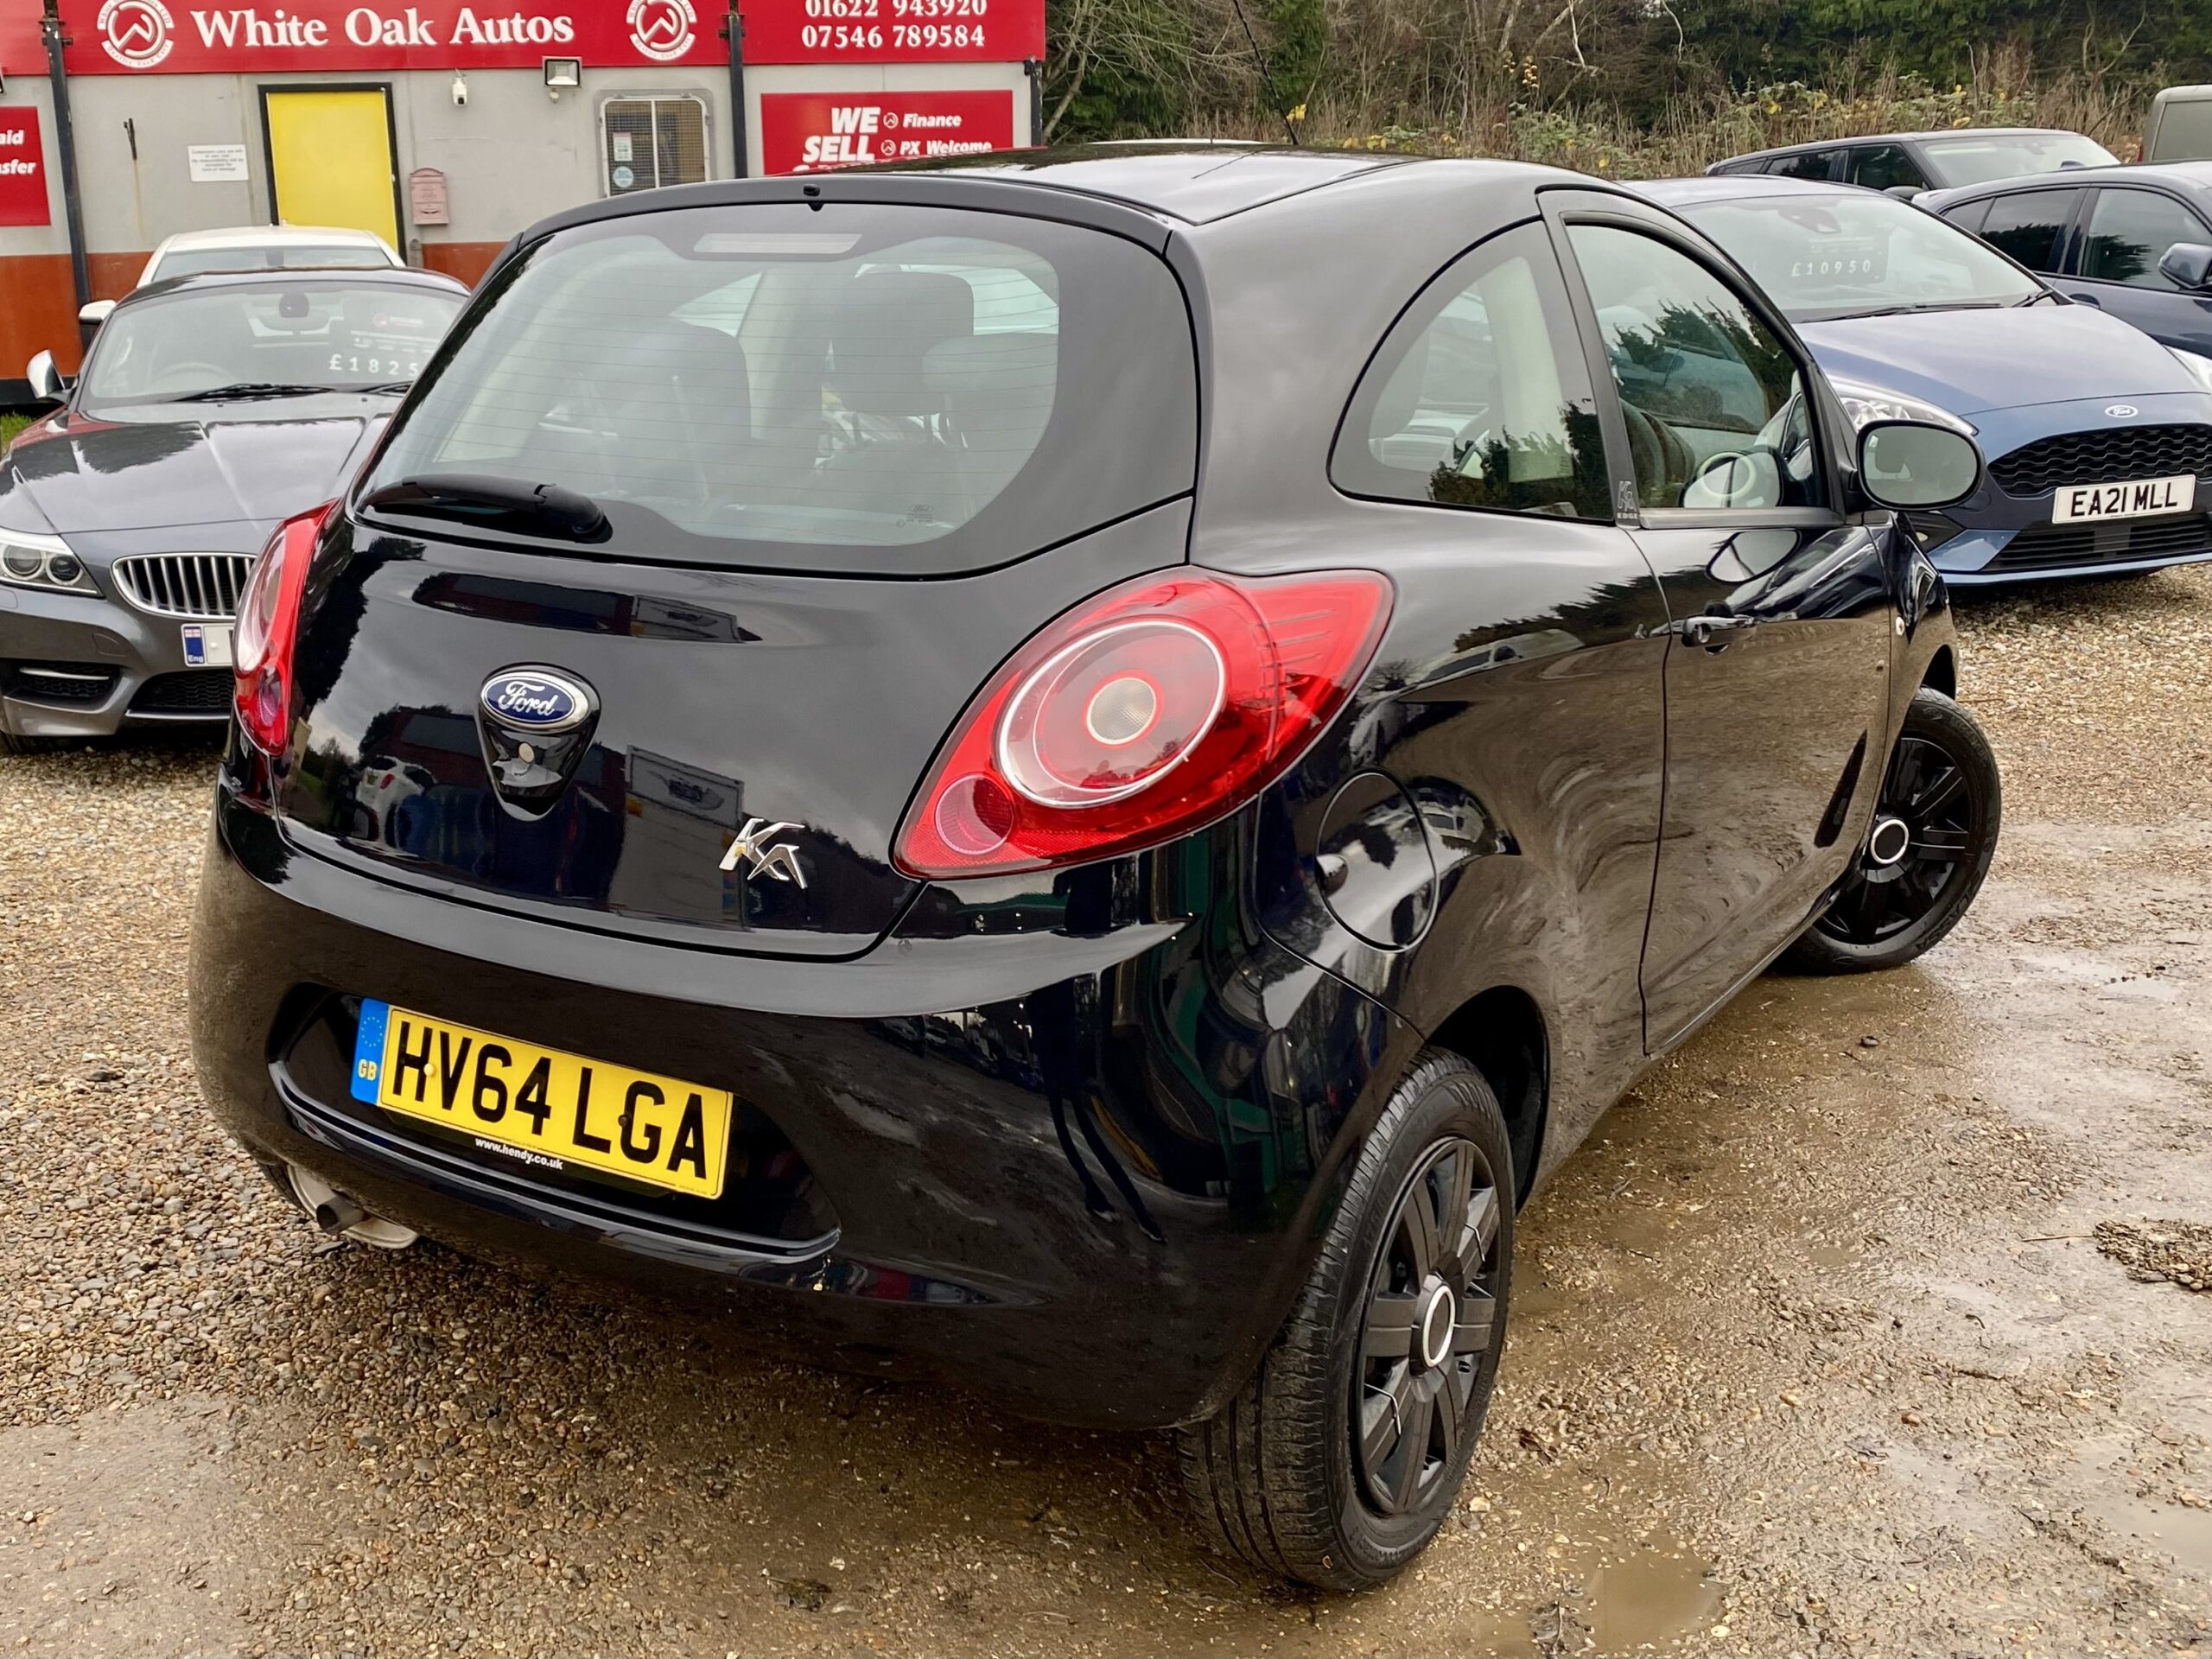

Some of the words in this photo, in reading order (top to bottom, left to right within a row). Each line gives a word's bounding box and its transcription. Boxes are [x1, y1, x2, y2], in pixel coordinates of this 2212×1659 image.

[805, 0, 879, 17] 01622
[893, 0, 988, 16] 943920
[189, 9, 329, 48] White
[345, 8, 437, 47] Oak
[448, 8, 575, 44] Autos
[801, 25, 883, 48] 07546
[892, 25, 985, 48] 789584
[831, 107, 881, 134] WE
[903, 113, 962, 128] Finance
[803, 135, 875, 163] SELL
[899, 141, 920, 155] PX
[926, 140, 993, 155] Welcome
[0, 159, 36, 175] sfer
[1791, 259, 1872, 277] £10950
[2070, 486, 2128, 517] EA21
[2133, 482, 2177, 511] MLL
[188, 654, 204, 664] Eng
[498, 680, 559, 716] Ford
[358, 1059, 378, 1082] GB
[392, 1020, 552, 1136] HV64
[572, 1067, 707, 1180] LGA
[475, 1138, 563, 1170] www.hendy.co.uk
